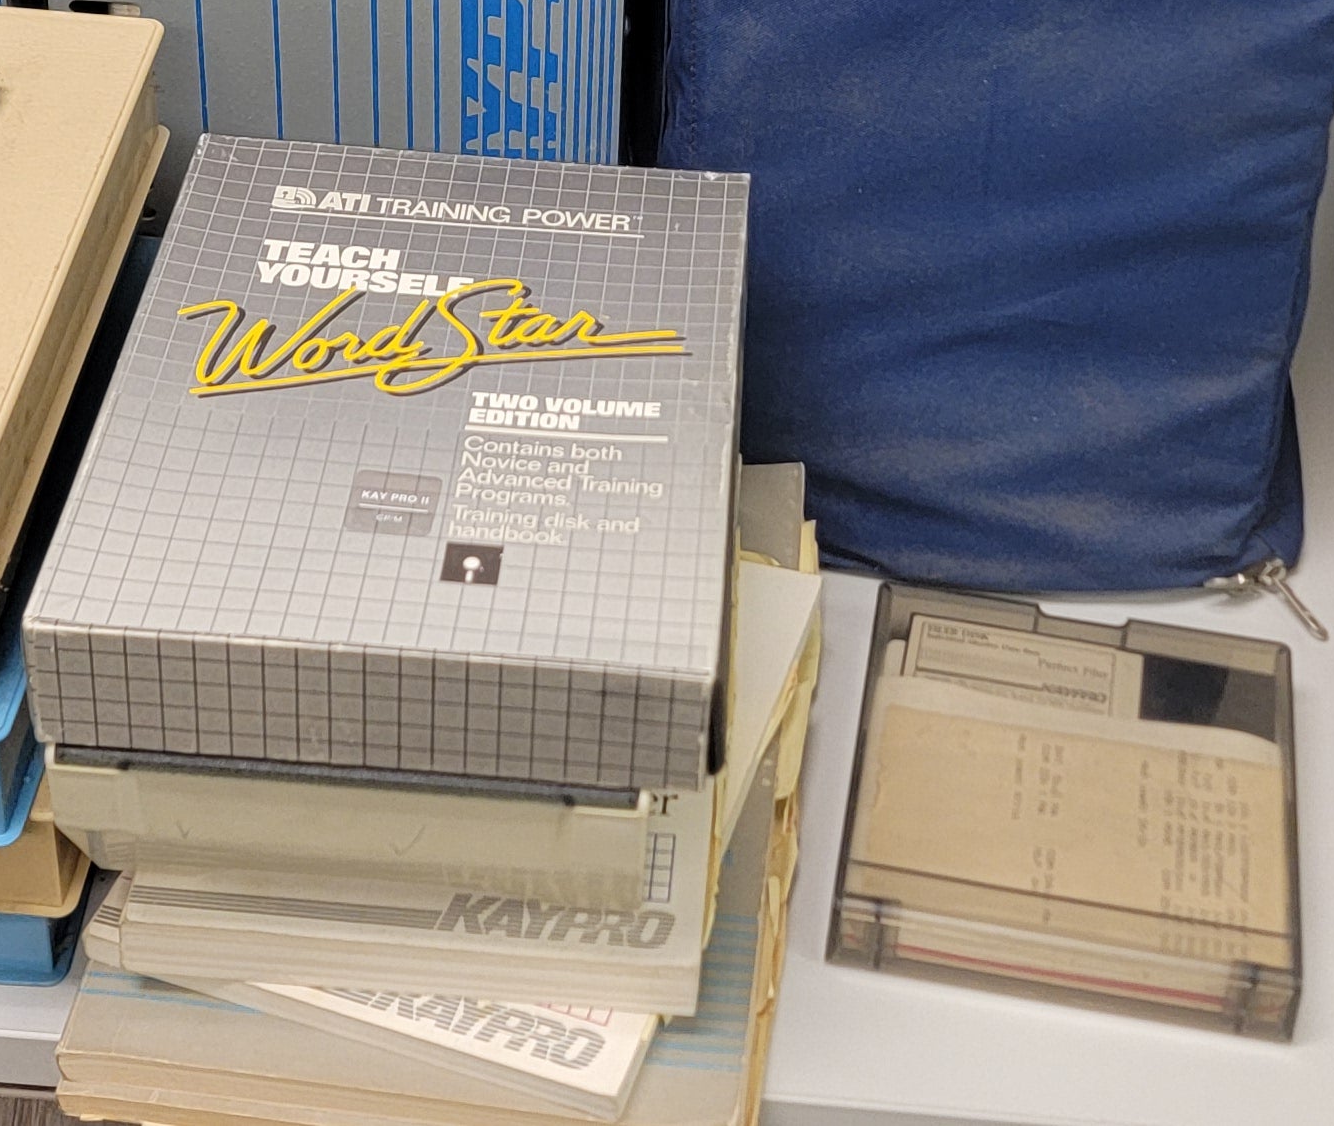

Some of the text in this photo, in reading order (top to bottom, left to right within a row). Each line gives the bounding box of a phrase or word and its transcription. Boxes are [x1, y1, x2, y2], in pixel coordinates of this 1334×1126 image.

[316, 190, 633, 232] ATI TRAINING POWER
[265, 240, 400, 272] TEACH
[257, 262, 474, 297] YOURSELF
[468, 408, 580, 431] EDITION
[472, 392, 661, 418] TWO VOLUME
[461, 451, 589, 475] Novice and
[464, 435, 623, 462] Contains both
[361, 489, 388, 501] KAY
[390, 492, 418, 504] PRO
[454, 482, 571, 507] Programs.
[457, 467, 664, 498] Advanced Training
[452, 504, 640, 534] Training disk and
[437, 893, 676, 949] KAYPRO
[369, 991, 606, 1070] KAYPRO
